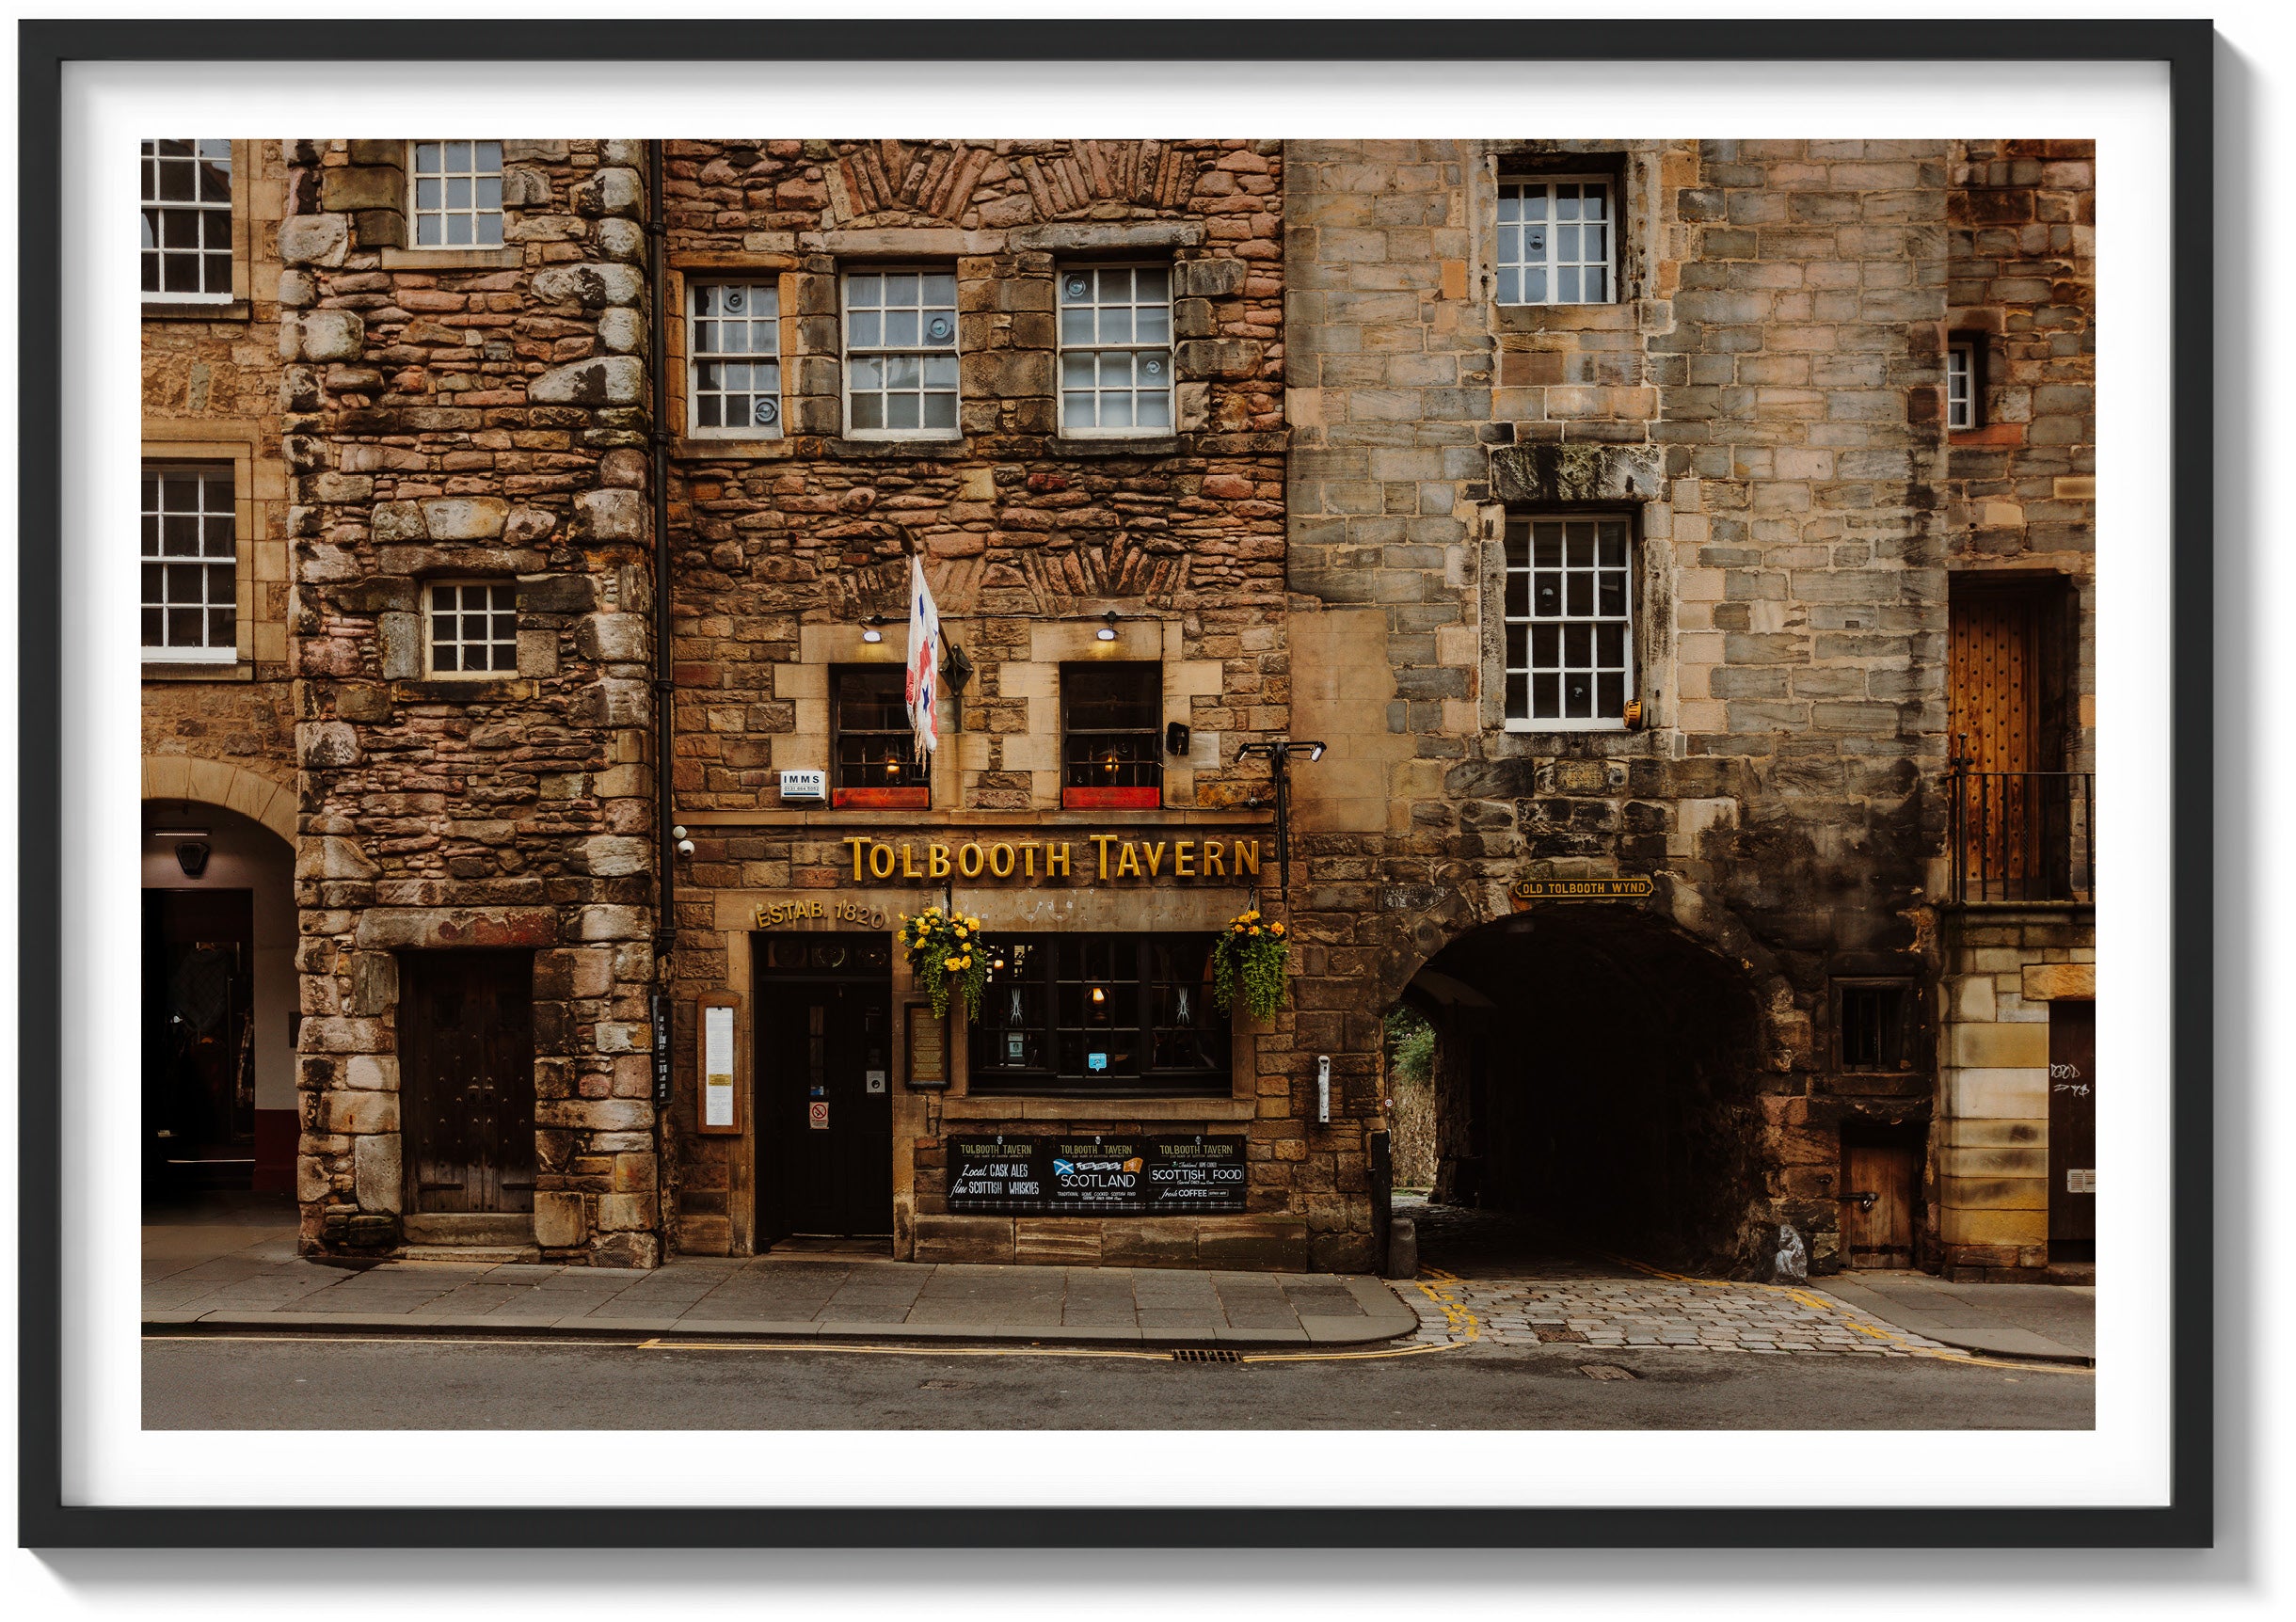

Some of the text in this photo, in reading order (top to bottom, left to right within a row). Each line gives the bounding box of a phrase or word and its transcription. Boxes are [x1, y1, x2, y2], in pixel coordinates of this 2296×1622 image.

[844, 835, 1260, 882] TOLBOOTH TAVERN
[1523, 883, 1645, 894] OLD TOLBOOTH WYND
[756, 900, 885, 929] ESTAB. 1820
[960, 1145, 1032, 1154] TOLBOOTH TAVERN
[1060, 1145, 1132, 1154] TOLBOOTH TAVERN
[1159, 1145, 1233, 1154] TOLBOOTH TAVERN
[962, 1163, 1028, 1177] Local CASK ALES
[1152, 1169, 1242, 1180] SCOTTISH FOOD
[1061, 1174, 1135, 1187] SCOTLAND
[949, 1178, 1039, 1198] fine SCOTTISH WHISKIES
[1158, 1187, 1177, 1200] fresh
